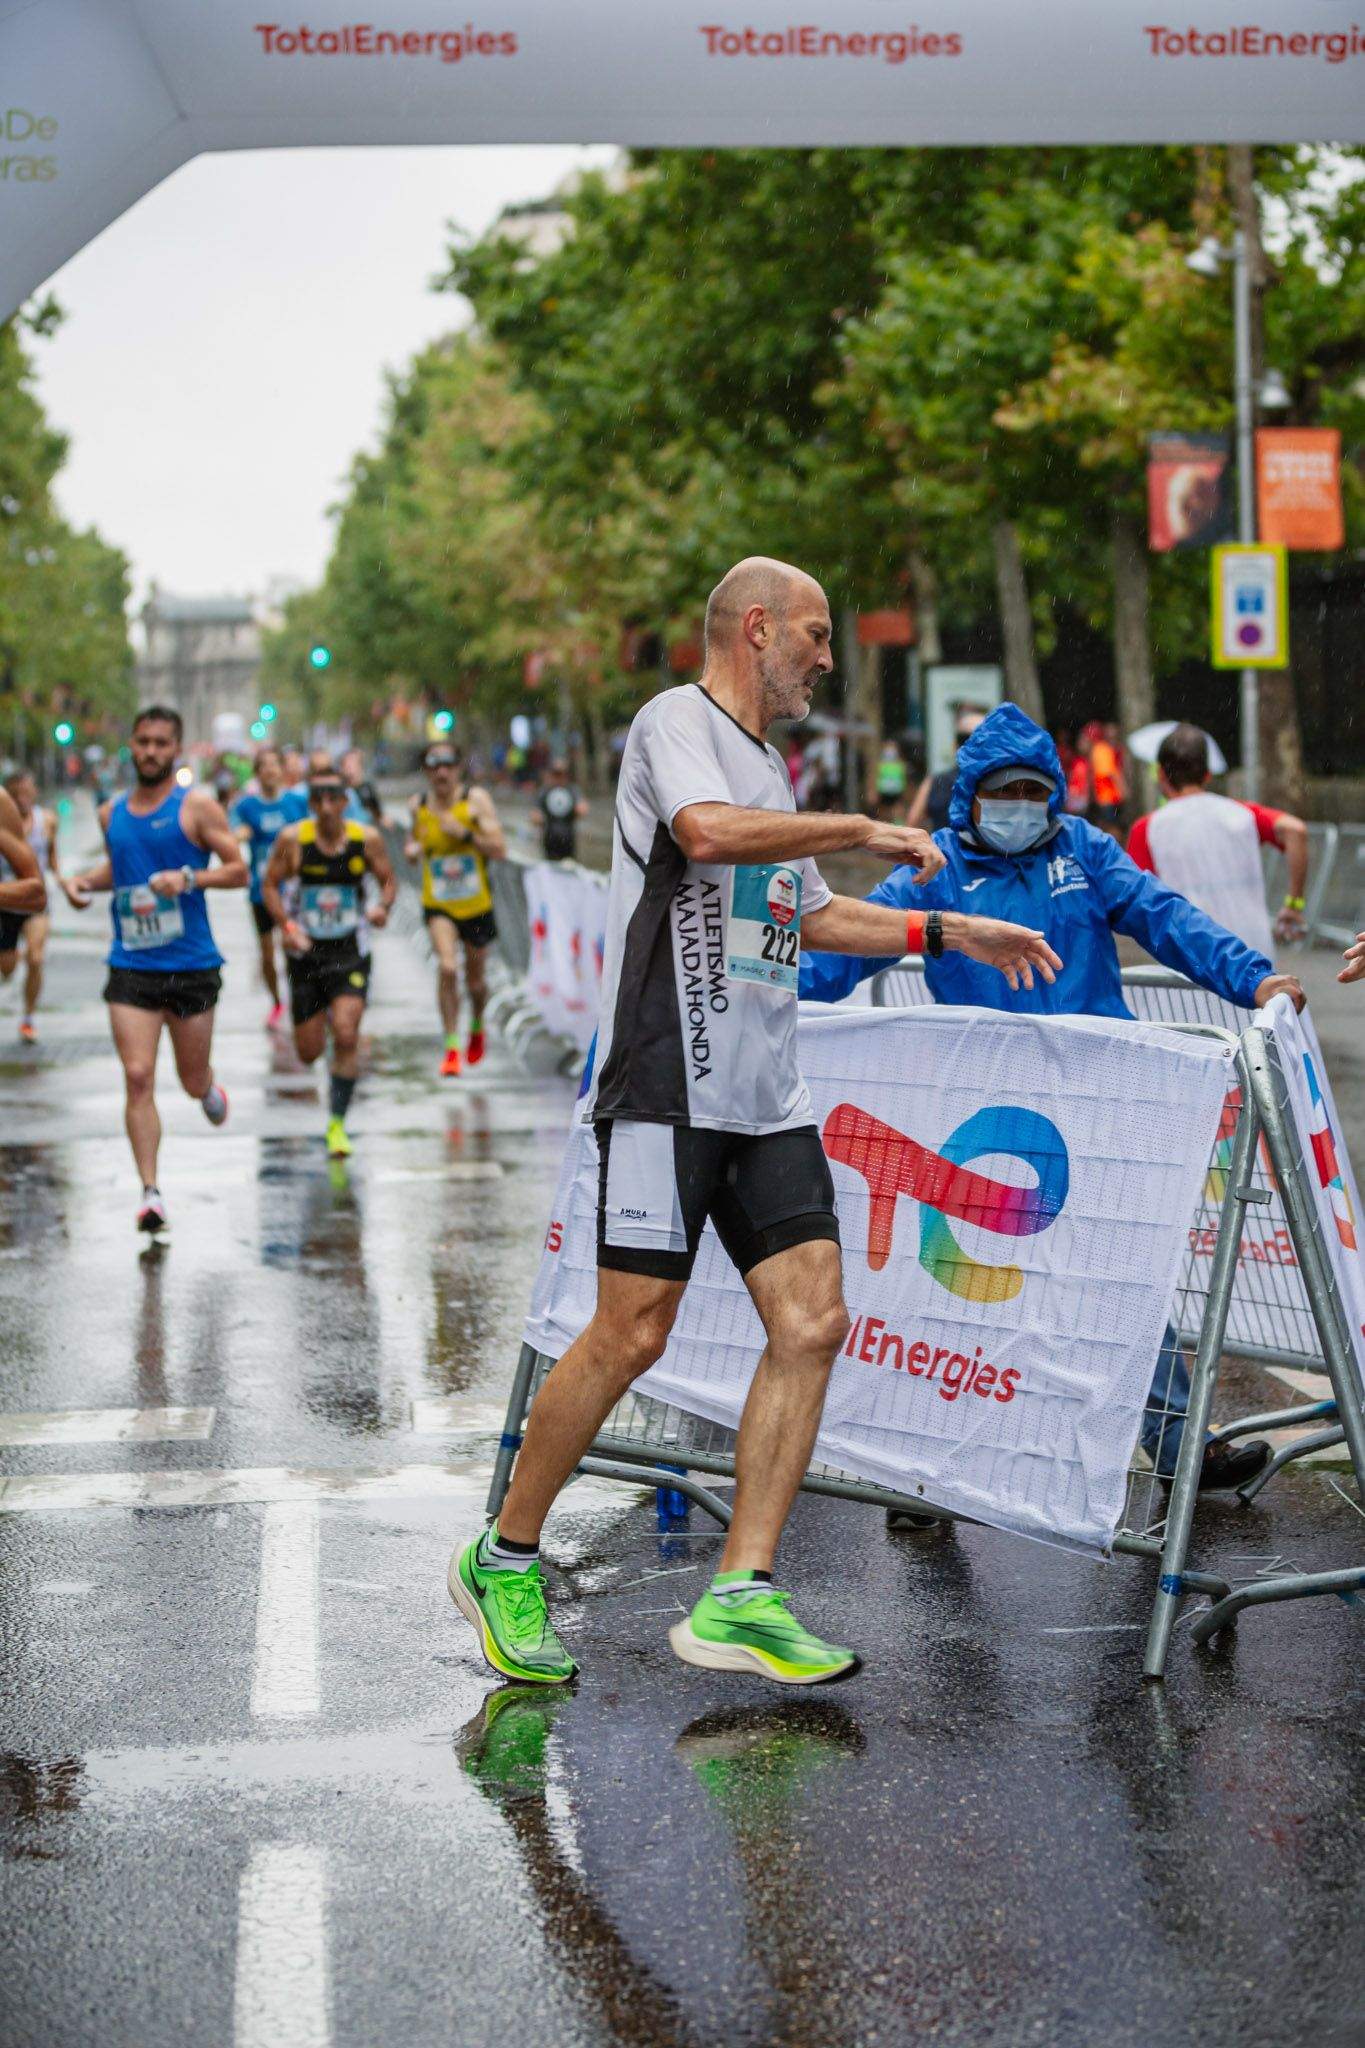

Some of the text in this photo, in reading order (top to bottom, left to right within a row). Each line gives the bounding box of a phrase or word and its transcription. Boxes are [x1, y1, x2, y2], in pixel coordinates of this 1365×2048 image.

[256, 24, 518, 63] TotalEnergies
[700, 25, 963, 64] TotalEnergies
[1146, 25, 1365, 64] TotalEnergi
[0, 107, 59, 142] De
[0, 155, 58, 182] ras
[700, 879, 729, 1014] ATLETISMO
[761, 924, 798, 968] 222
[673, 883, 713, 1082] MAJADAHONDA
[845, 1314, 1022, 1403] lEnergies
